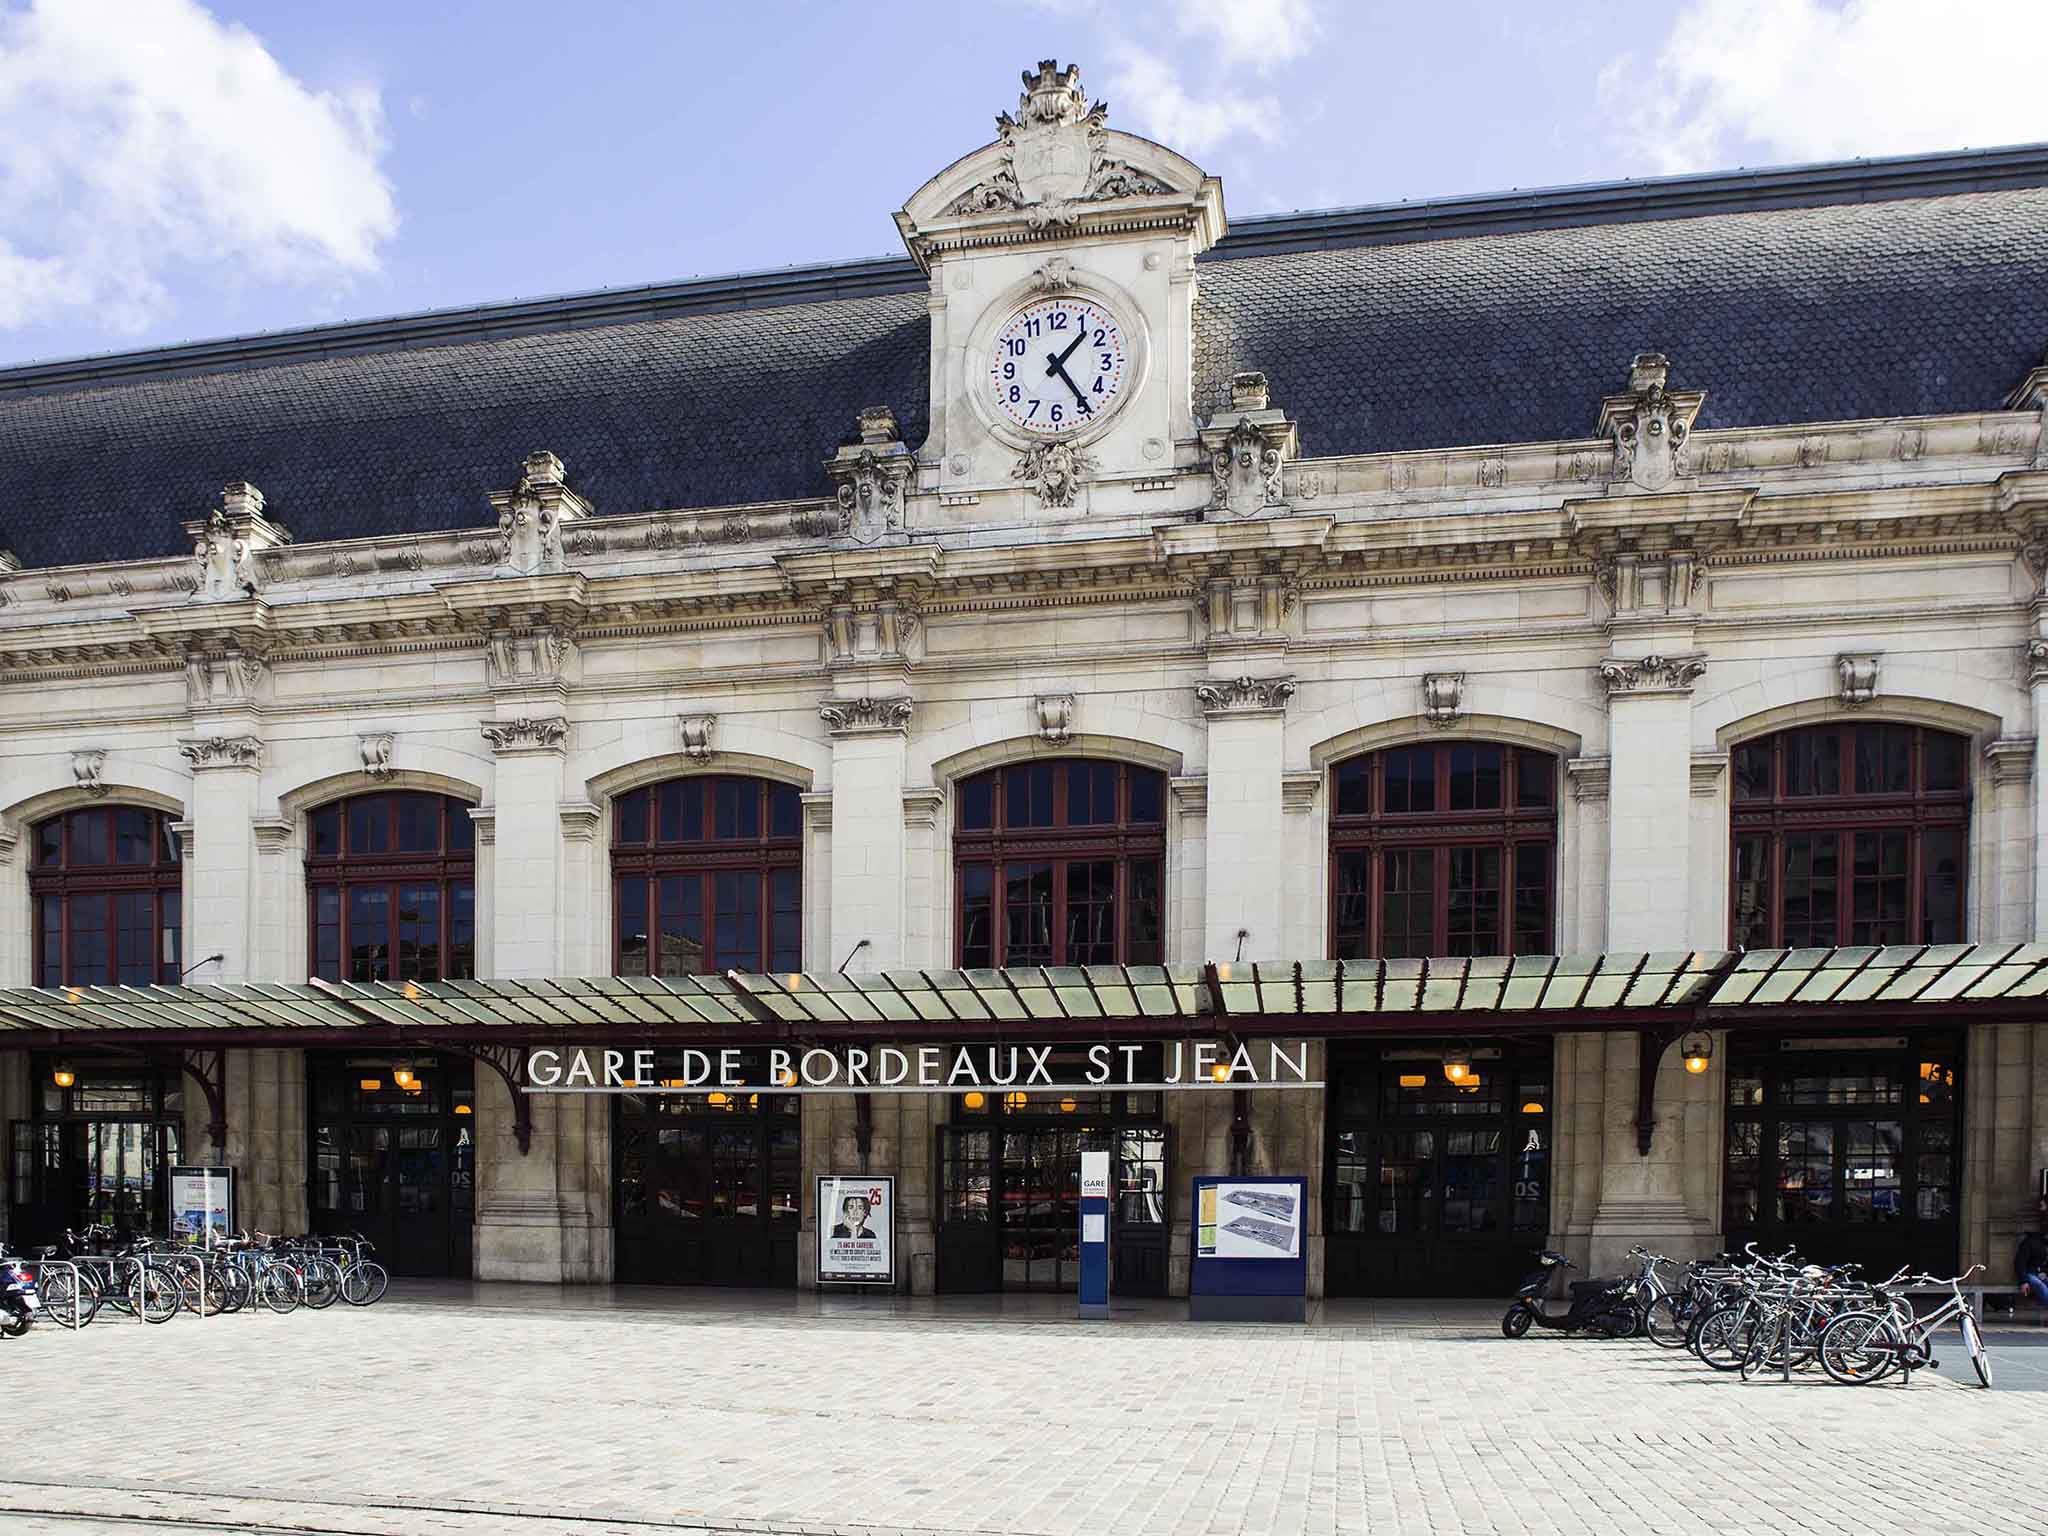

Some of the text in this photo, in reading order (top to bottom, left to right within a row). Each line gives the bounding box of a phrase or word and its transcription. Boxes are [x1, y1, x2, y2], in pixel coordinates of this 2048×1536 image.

[1024, 319, 1041, 337] 11
[1047, 312, 1067, 330] 12
[1077, 315, 1086, 332] 1
[1093, 329, 1106, 347] 2
[1006, 339, 1026, 356] 10
[1003, 362, 1015, 380] 9
[1101, 354, 1112, 371] 3
[1092, 376, 1104, 394] 4
[1009, 386, 1021, 403] 8
[1028, 400, 1040, 418] 7
[1051, 404, 1063, 421] 6
[528, 1042, 1307, 1086] GARE DE BORDEAUX ST JEAN
[869, 1187, 882, 1206] 25
